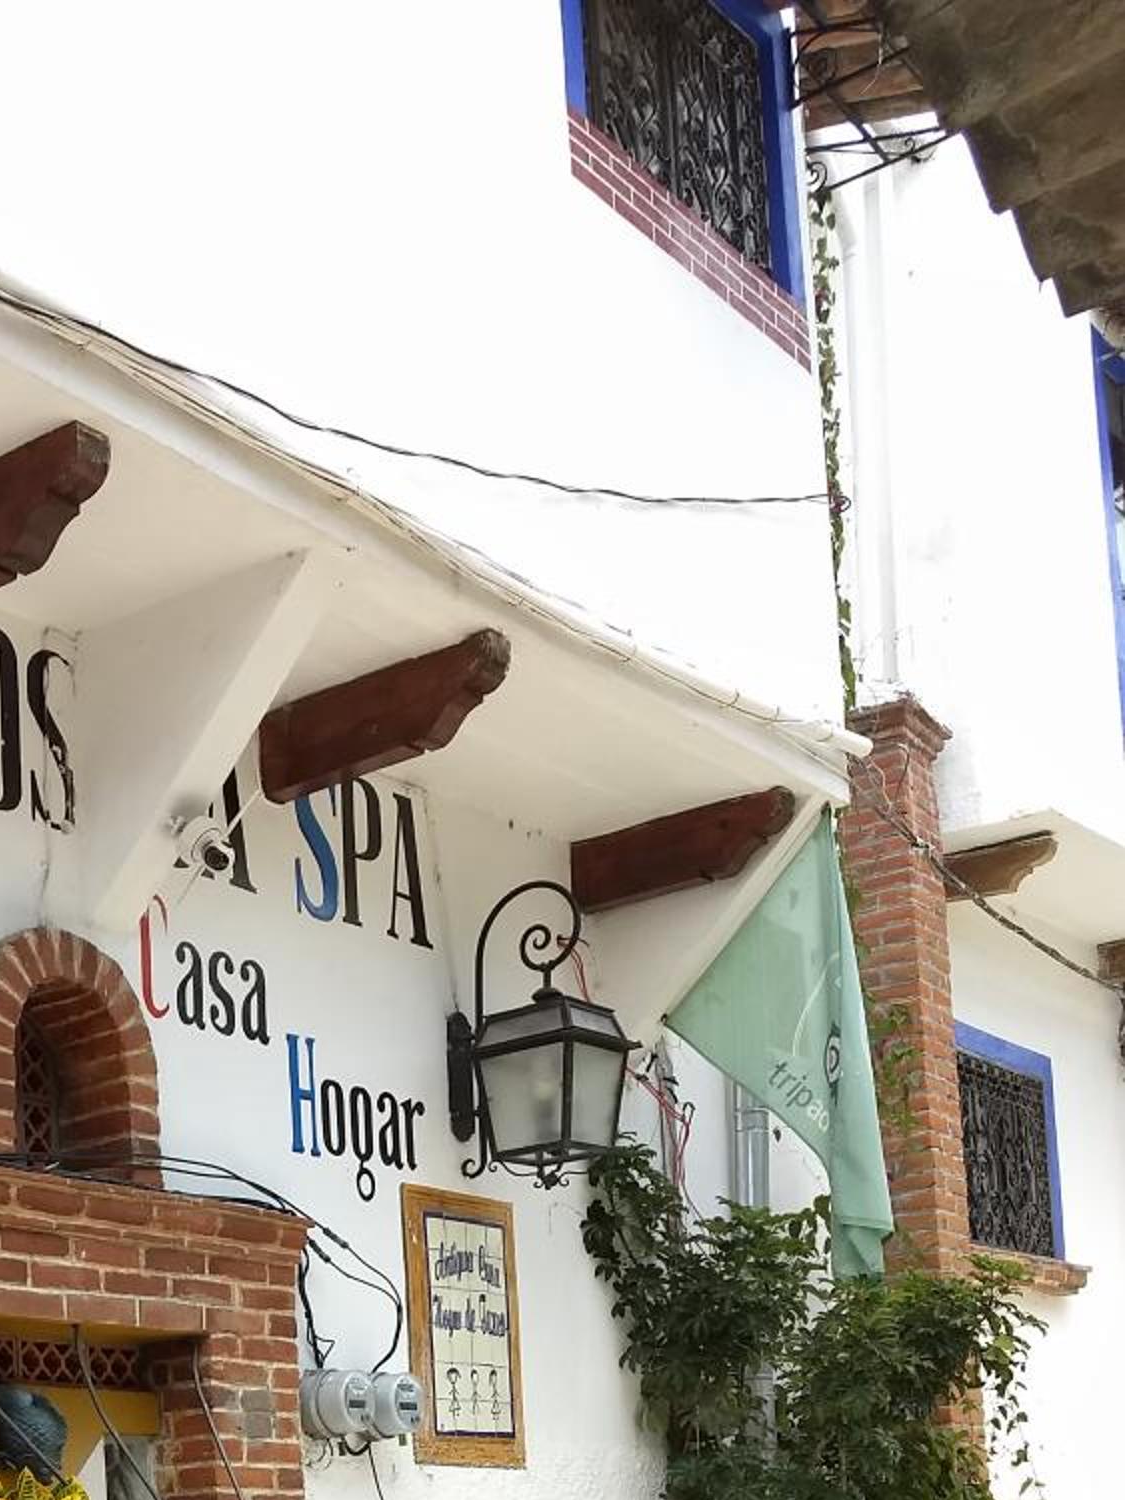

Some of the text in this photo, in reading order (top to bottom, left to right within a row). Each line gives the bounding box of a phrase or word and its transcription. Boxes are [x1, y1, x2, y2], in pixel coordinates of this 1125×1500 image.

[295, 777, 433, 949] SPA
[140, 894, 269, 1045] Casa
[286, 1033, 425, 1201] Hogar
